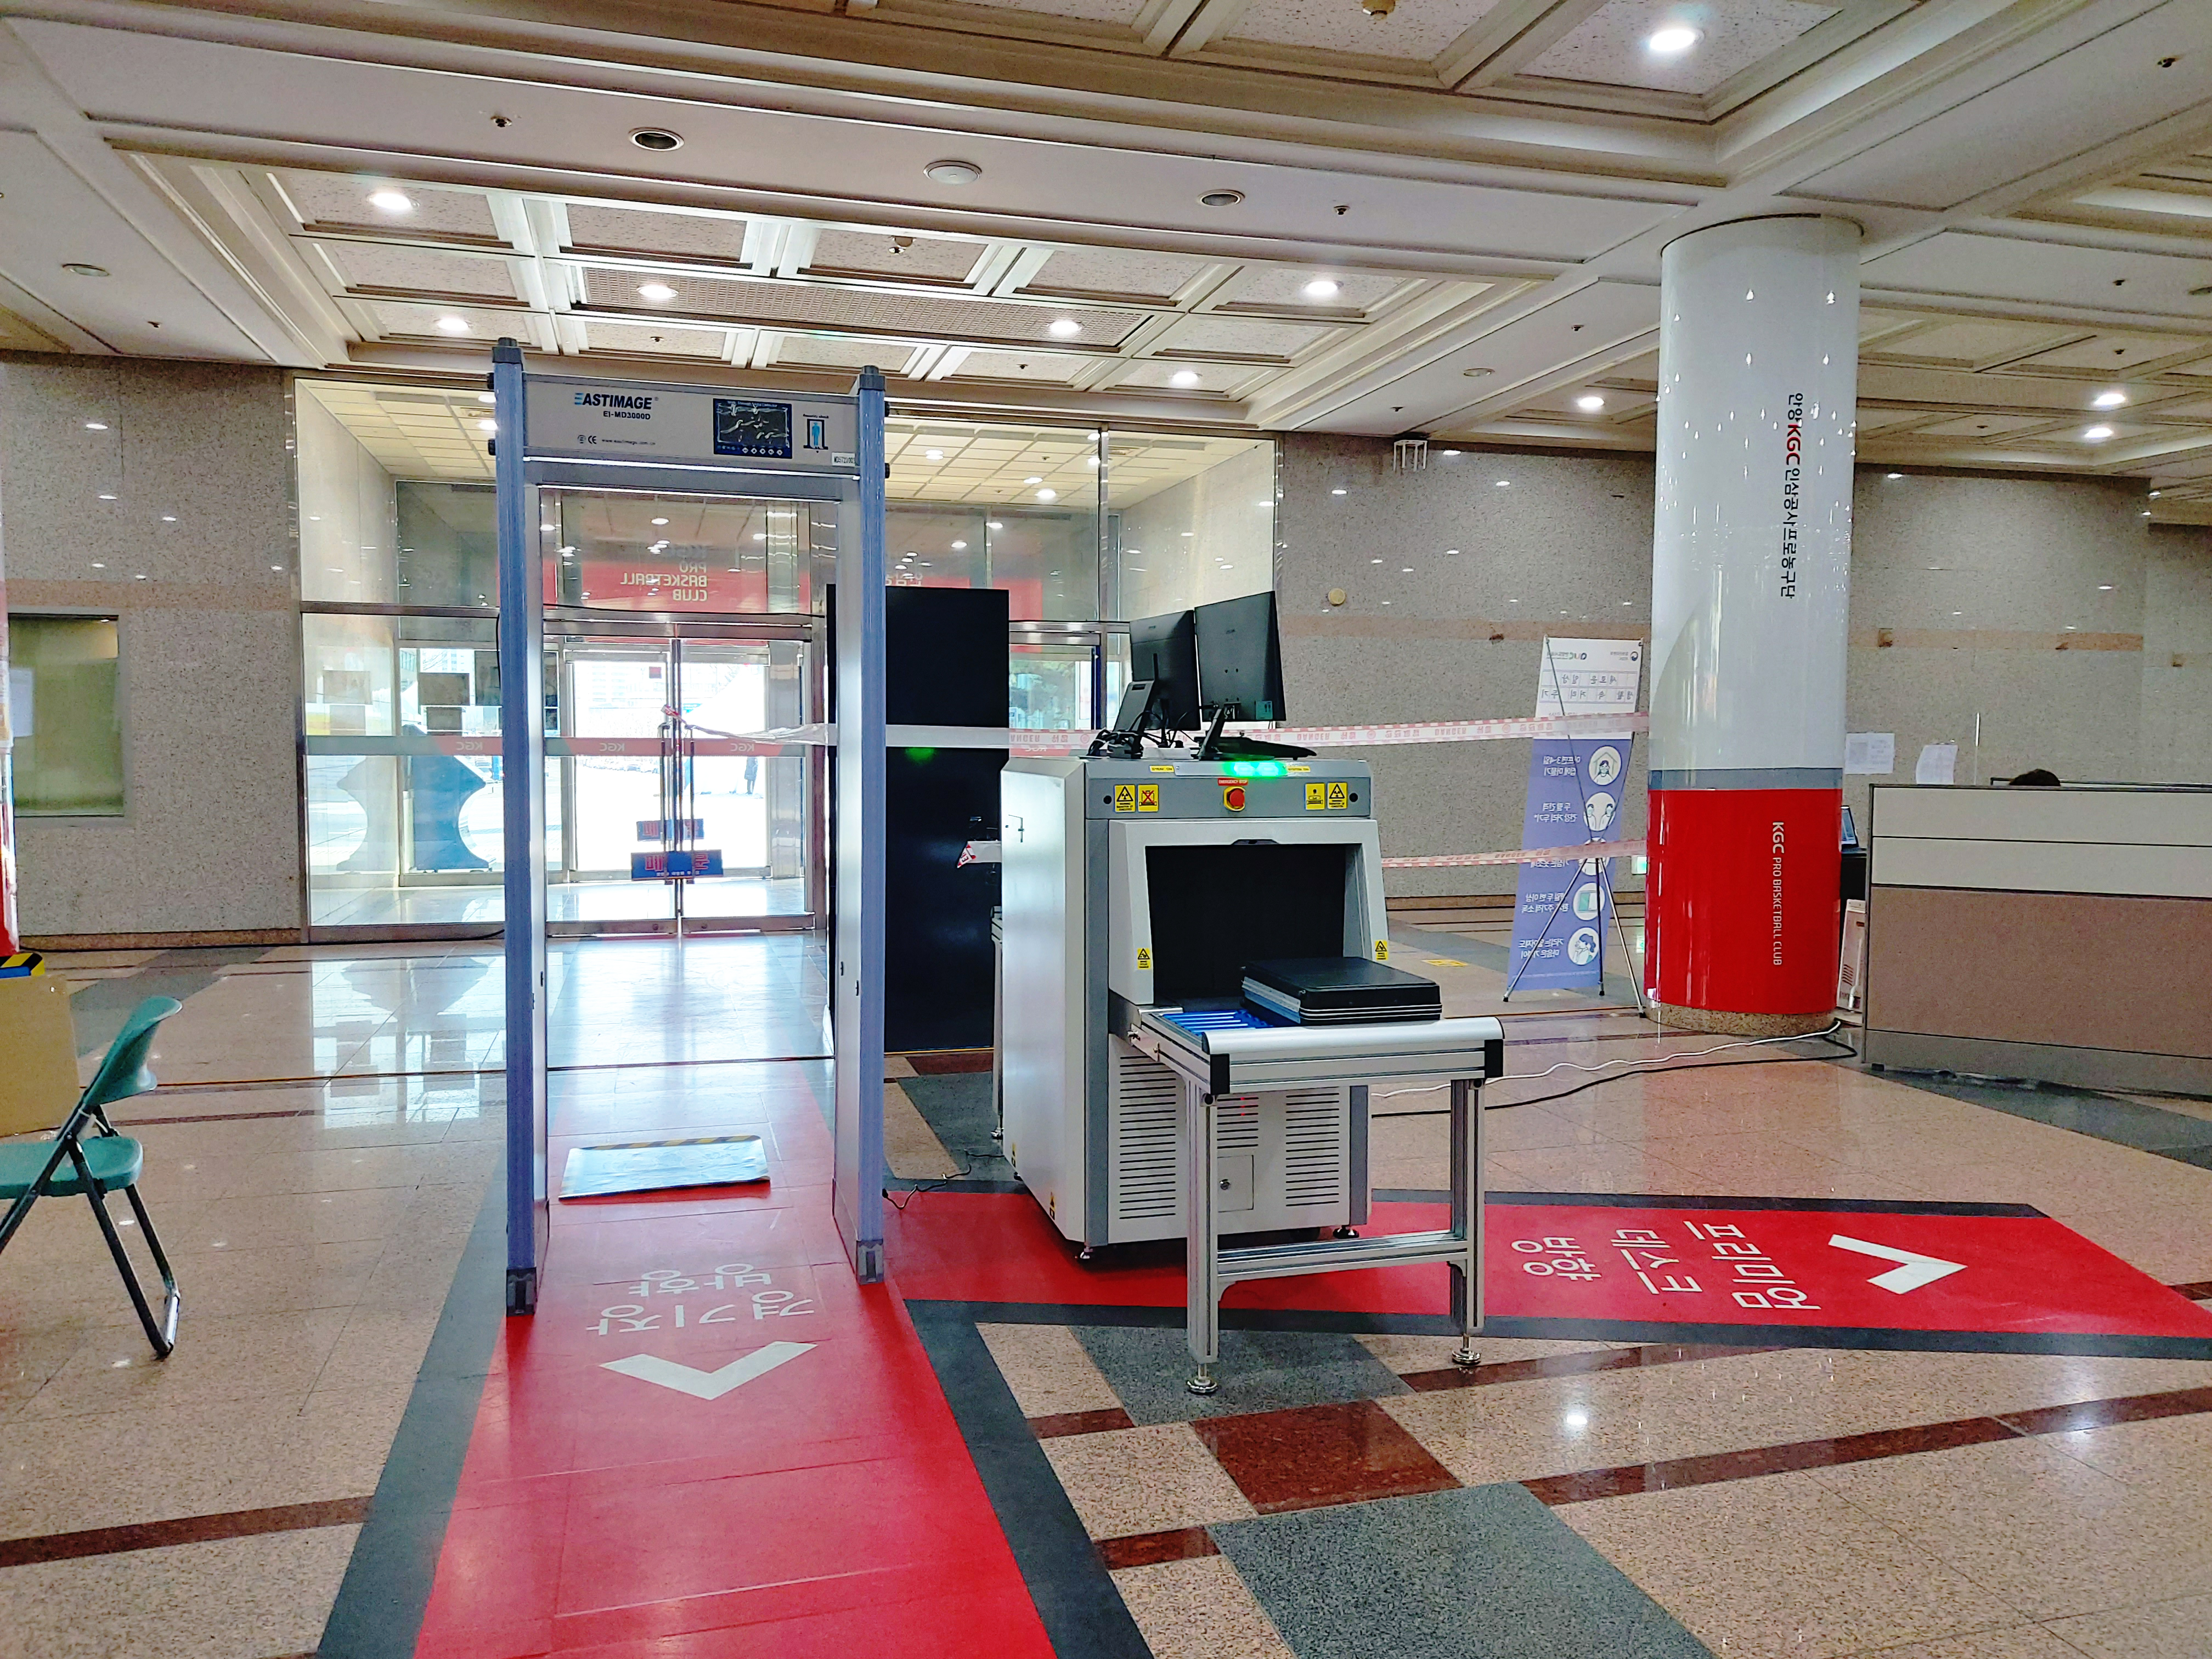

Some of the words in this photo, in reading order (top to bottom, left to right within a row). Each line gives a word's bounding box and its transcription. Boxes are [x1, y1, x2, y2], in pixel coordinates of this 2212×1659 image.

[574, 393, 652, 410] EASTIMAGE
[603, 410, 651, 420] EI-MD3000D
[1773, 822, 1785, 854] KGC
[1773, 857, 1782, 877] PRO
[1773, 879, 1782, 939] BASKETBALL
[1773, 941, 1782, 966] CLUB
[1511, 1236, 1602, 1282] 방향
[1610, 1228, 1703, 1295] 데스크
[1683, 1220, 1821, 1310] 프리미엄
[628, 1262, 771, 1297] 방향
[585, 1290, 814, 1336] 경기장
